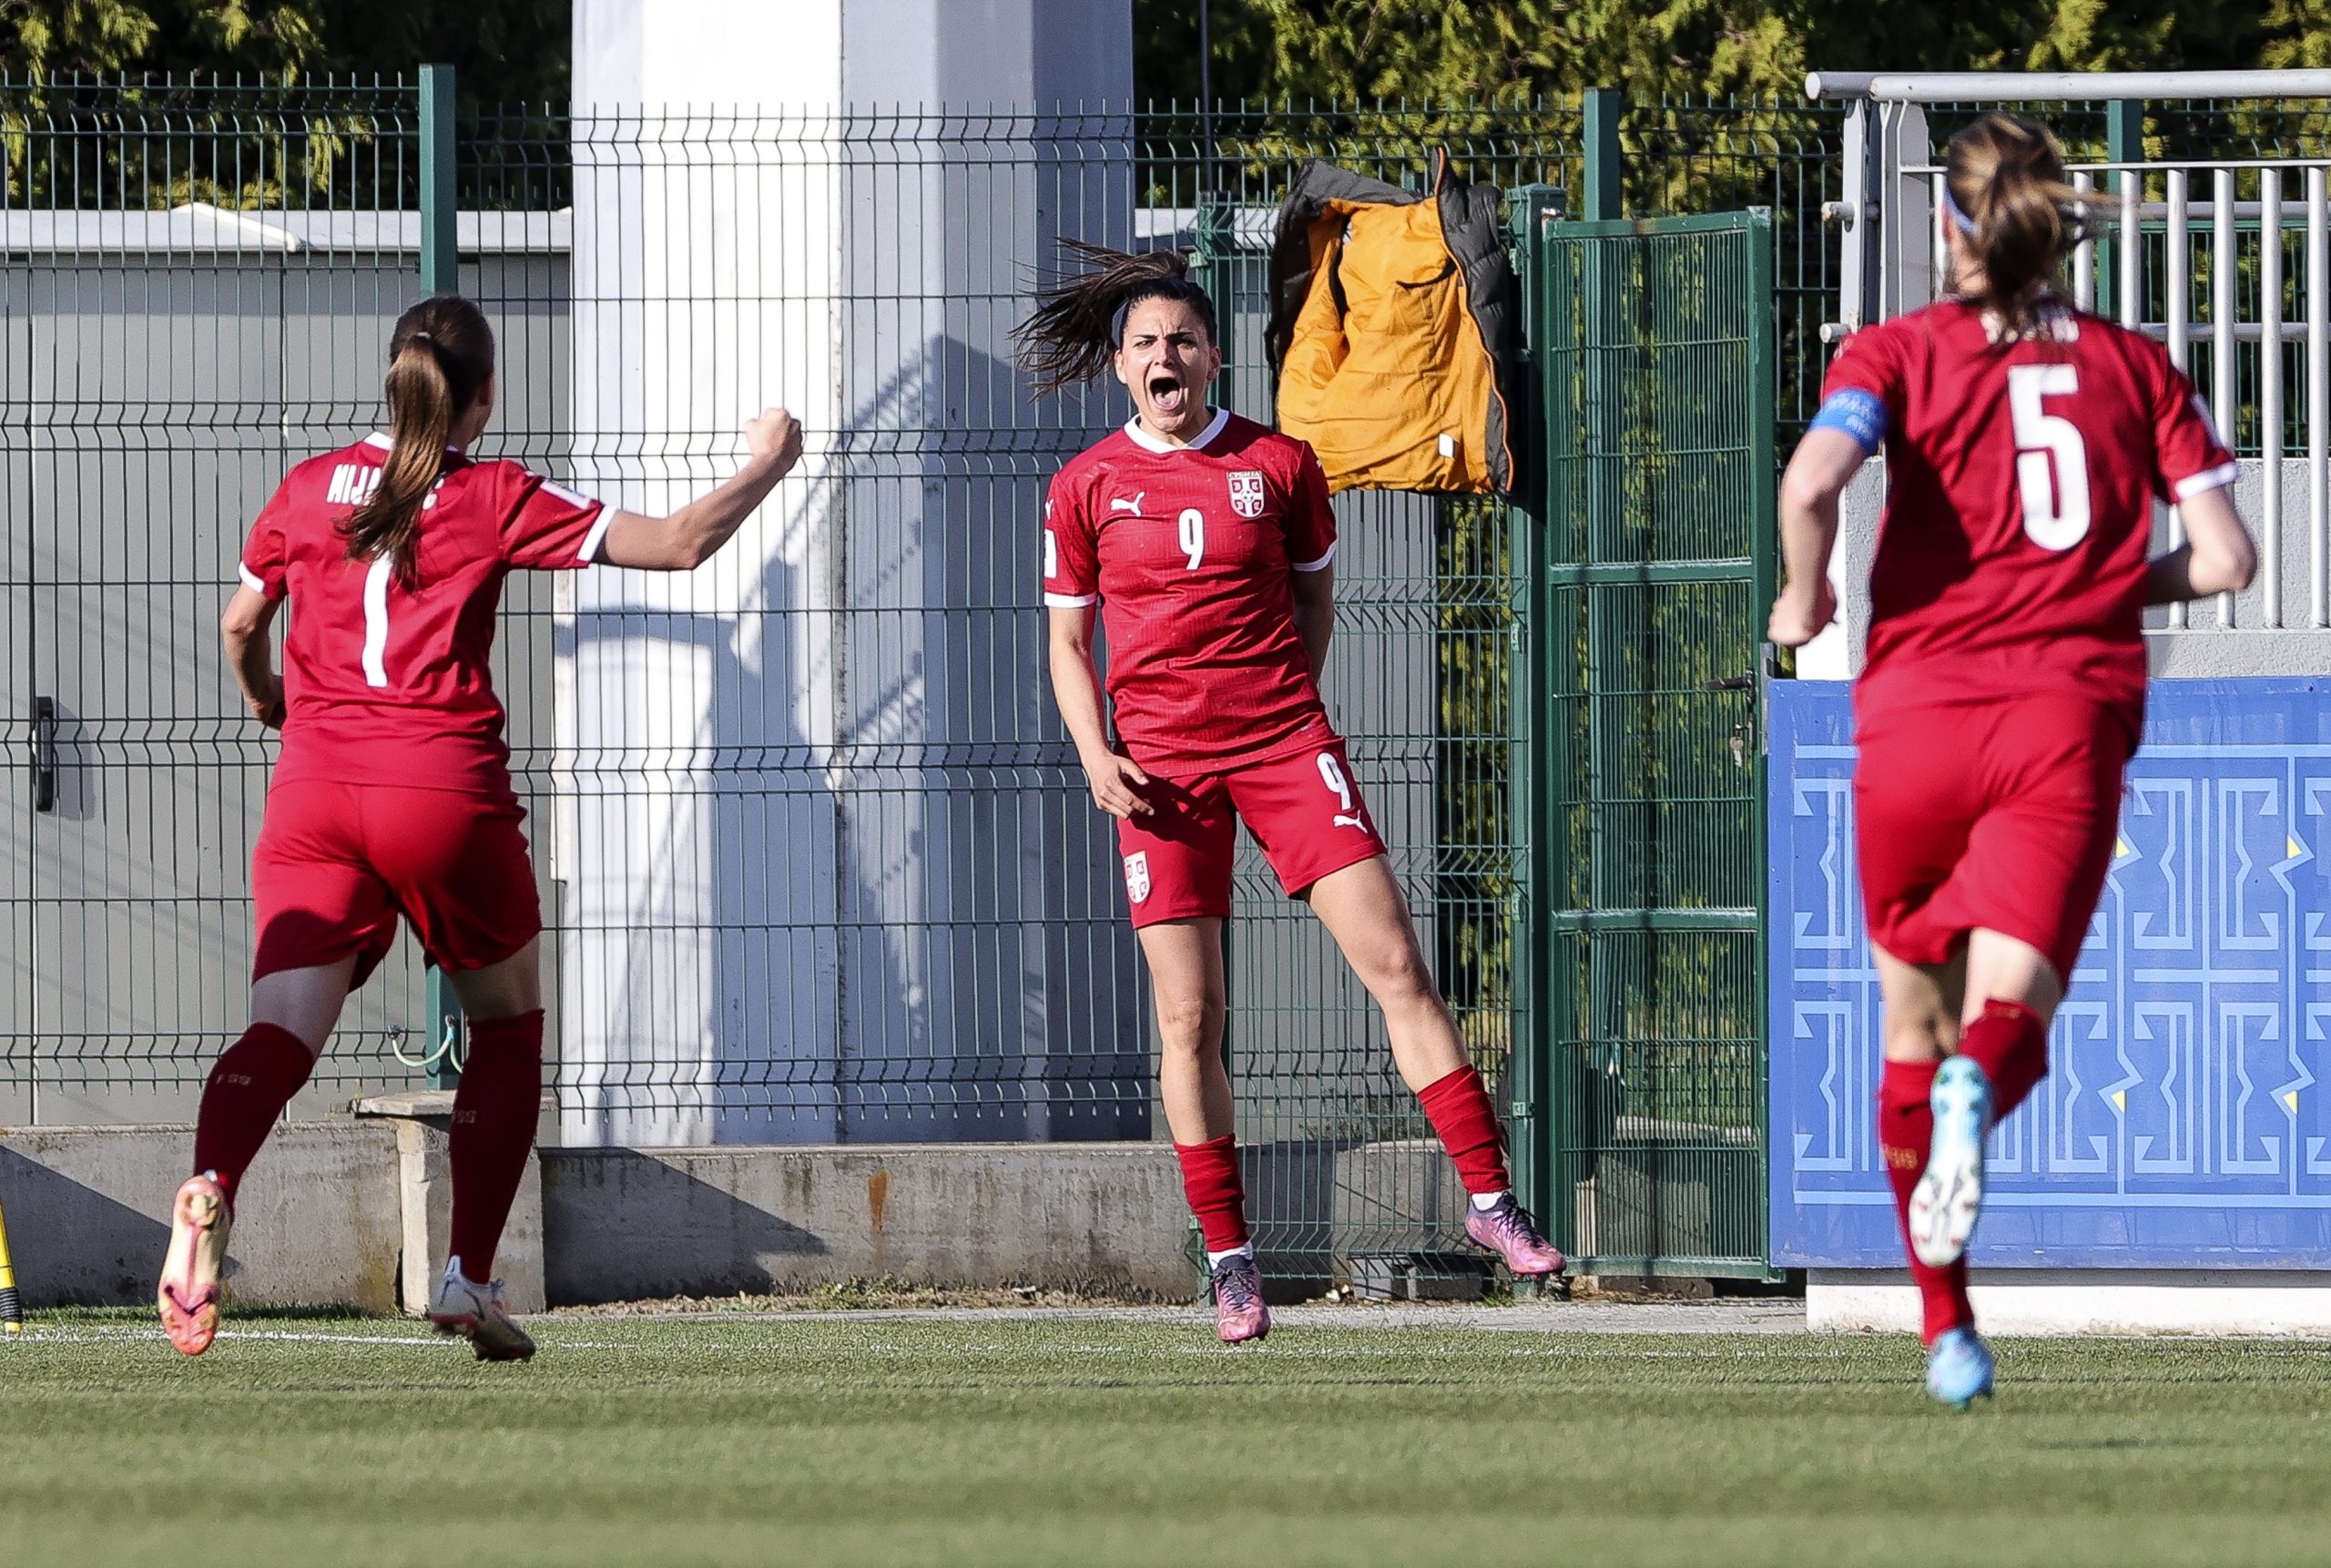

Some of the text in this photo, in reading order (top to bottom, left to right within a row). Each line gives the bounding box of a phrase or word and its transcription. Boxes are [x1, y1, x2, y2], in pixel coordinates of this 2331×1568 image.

[2008, 364, 2091, 552] 5
[1178, 507, 1204, 571] 9
[1317, 752, 1351, 810] 9
